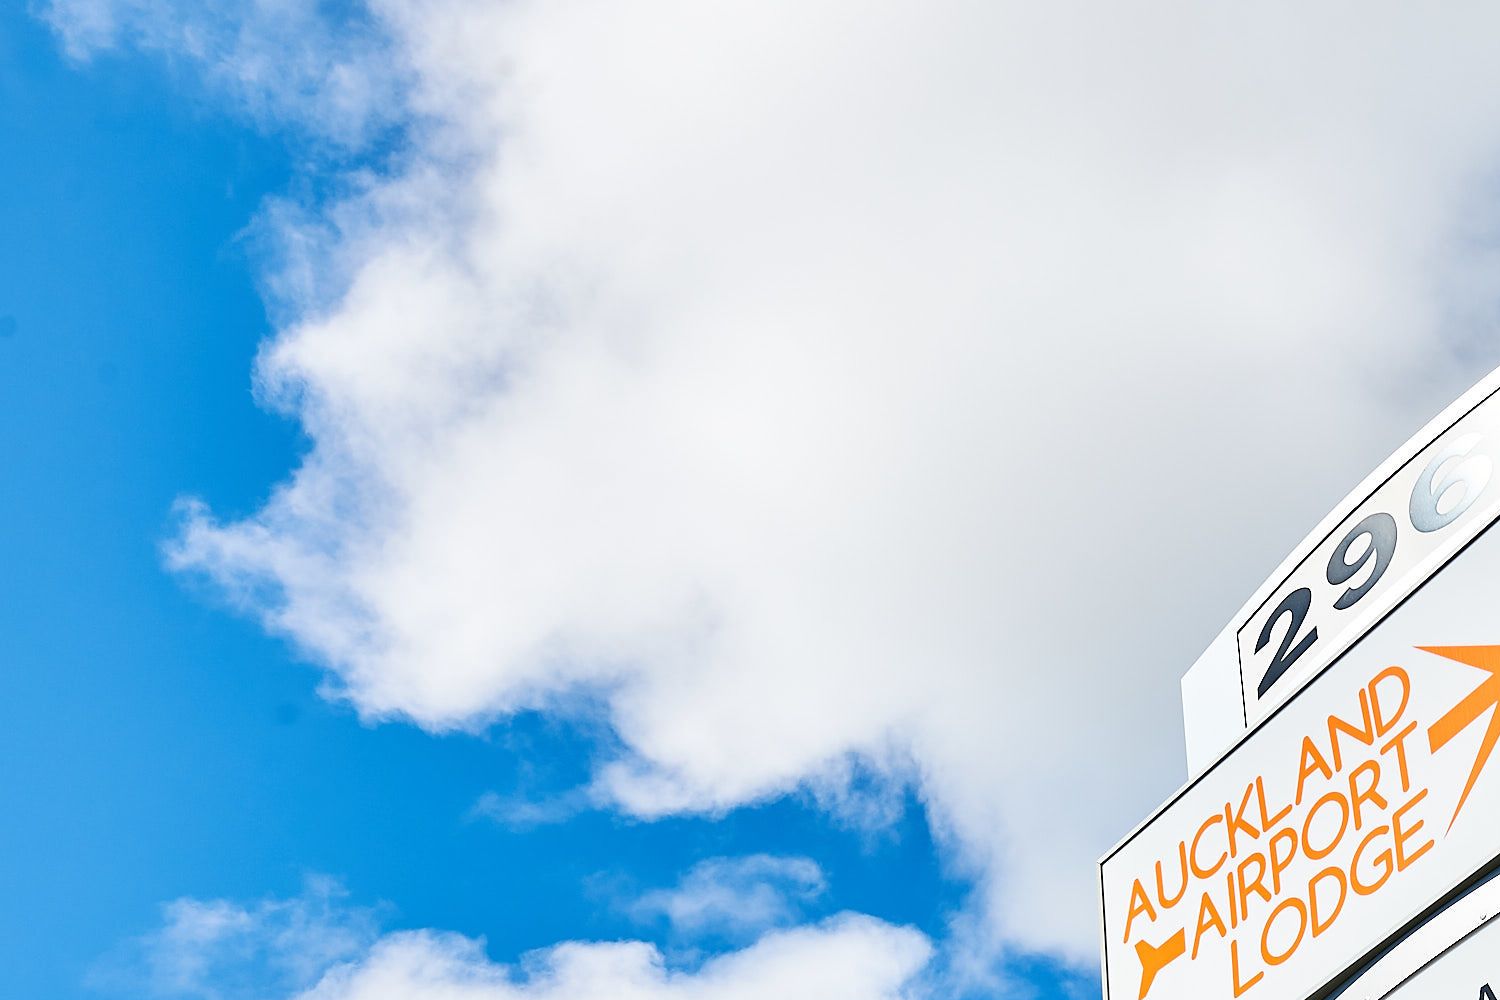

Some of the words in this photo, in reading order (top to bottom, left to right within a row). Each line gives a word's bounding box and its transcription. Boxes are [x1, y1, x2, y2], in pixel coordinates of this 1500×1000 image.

[1254, 432, 1494, 700] 296
[1123, 665, 1411, 943] AUCKLAND
[1191, 720, 1418, 960] AIRPORT
[1230, 788, 1435, 998] LODGE
